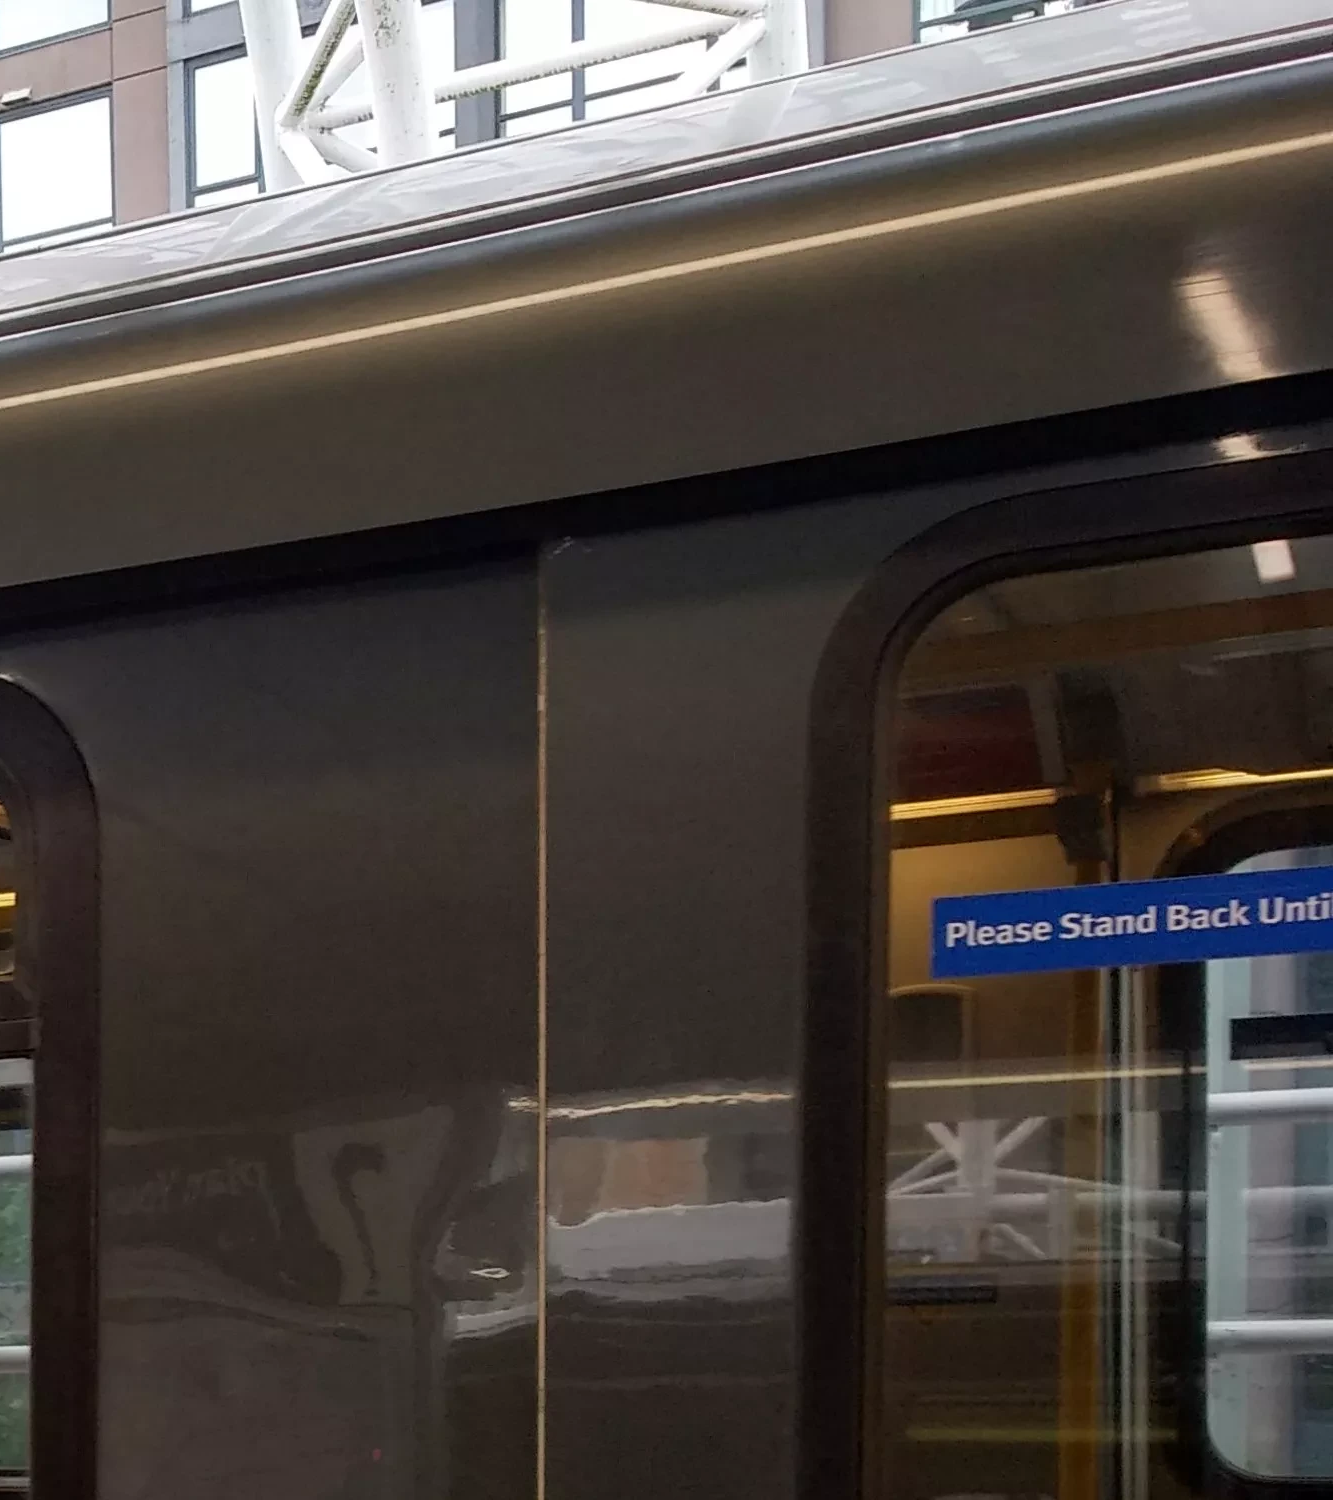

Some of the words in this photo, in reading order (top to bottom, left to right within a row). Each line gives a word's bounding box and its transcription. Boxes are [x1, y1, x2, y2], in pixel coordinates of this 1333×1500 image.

[944, 918, 1052, 948] Please
[1057, 904, 1158, 940] Stand
[1166, 898, 1252, 932] Back
[1257, 891, 1333, 925] Unti
